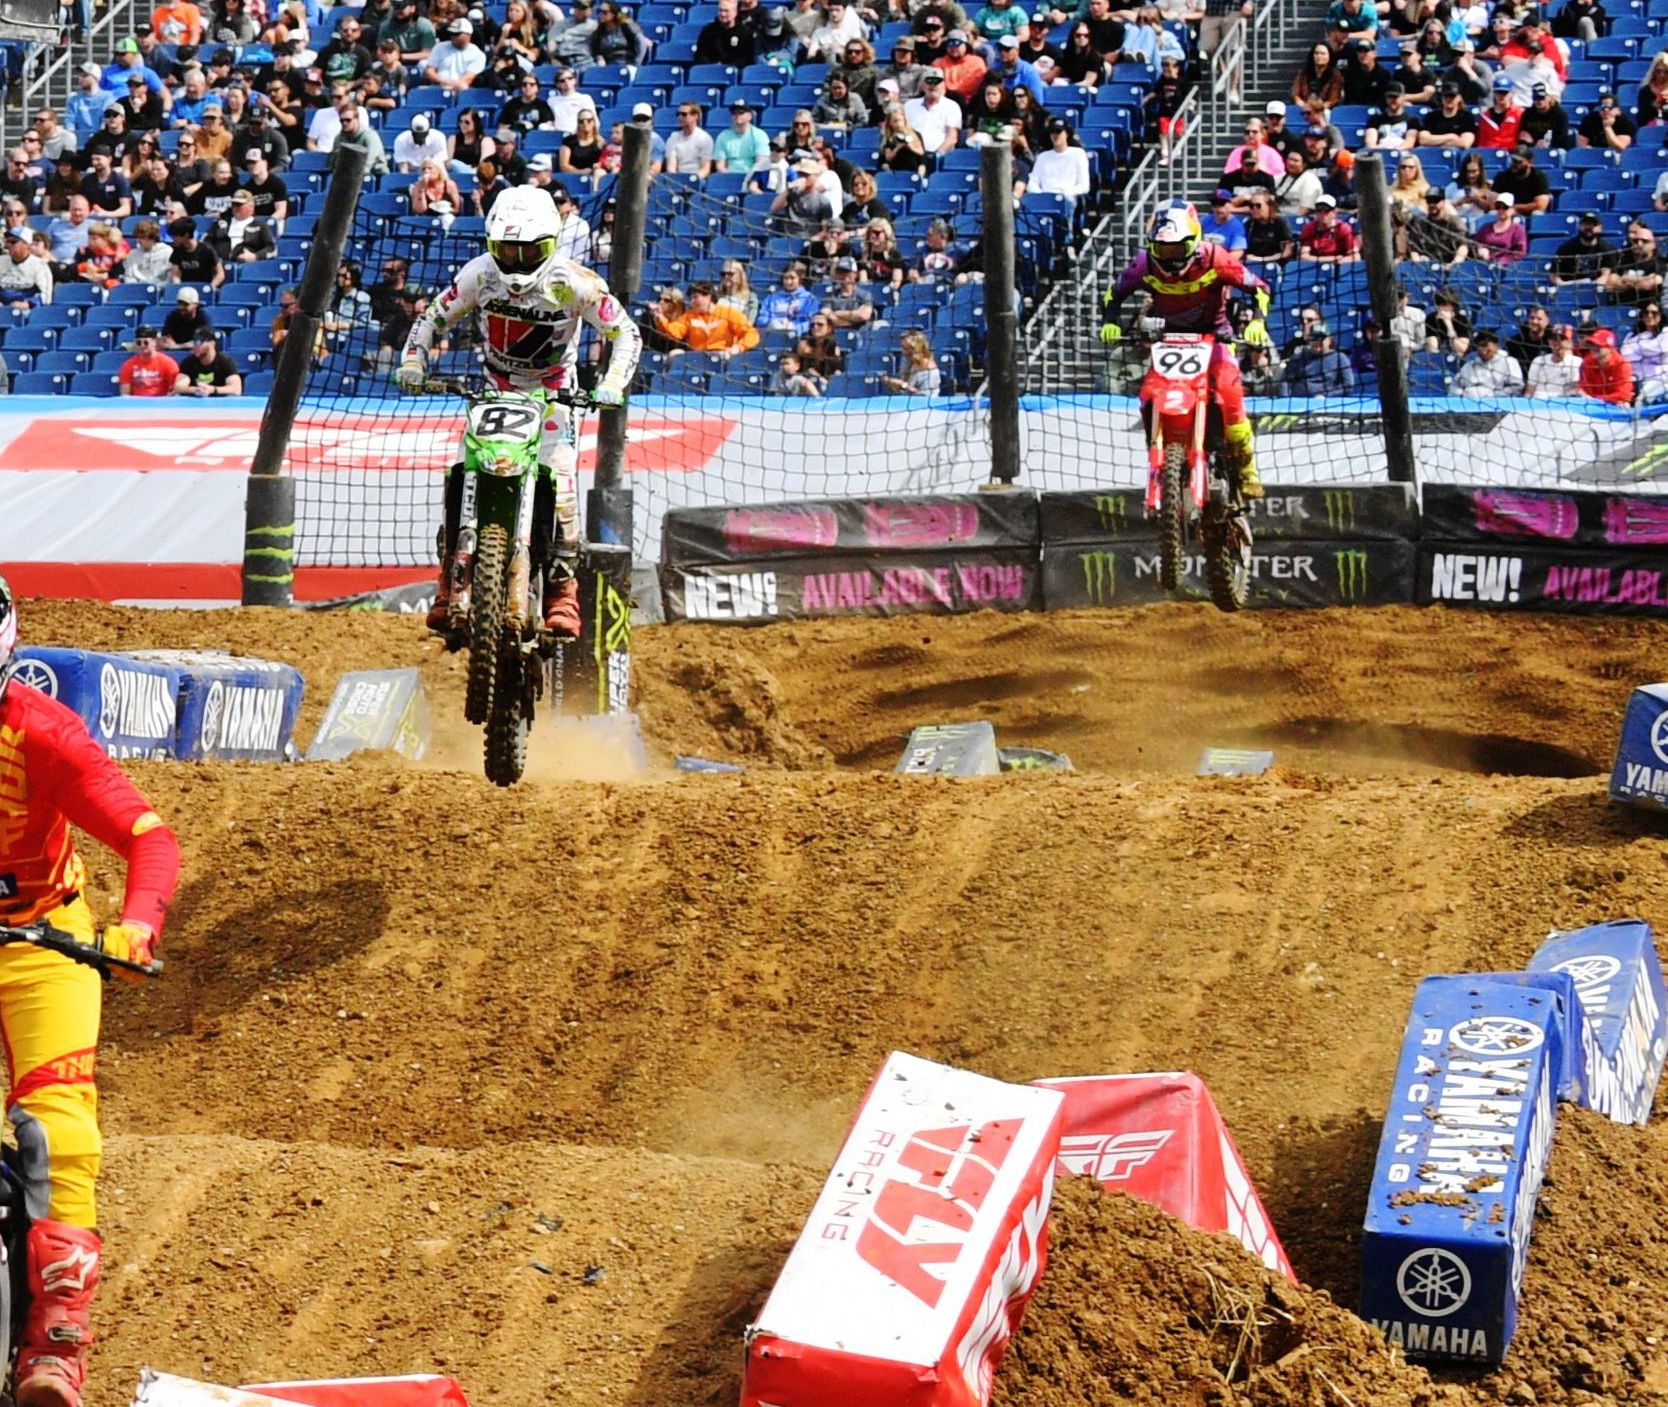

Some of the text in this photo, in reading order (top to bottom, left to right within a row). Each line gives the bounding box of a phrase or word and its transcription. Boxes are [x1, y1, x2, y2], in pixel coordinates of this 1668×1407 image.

[1159, 351, 1202, 375] 96
[476, 406, 536, 440] 82
[684, 564, 1023, 621] NEW! AVAILABLE NOW
[1431, 553, 1668, 606] NEW! AVAILABL
[118, 669, 176, 738] YAMAHA
[220, 687, 285, 751] YAMAHA
[1625, 761, 1668, 794] YAM
[1387, 1026, 1444, 1184] RACING
[1419, 1057, 1534, 1196] YAMAHA
[820, 1126, 894, 1244] RACING
[857, 1117, 1027, 1309] FLY
[1370, 1317, 1489, 1359] YAMAHA
